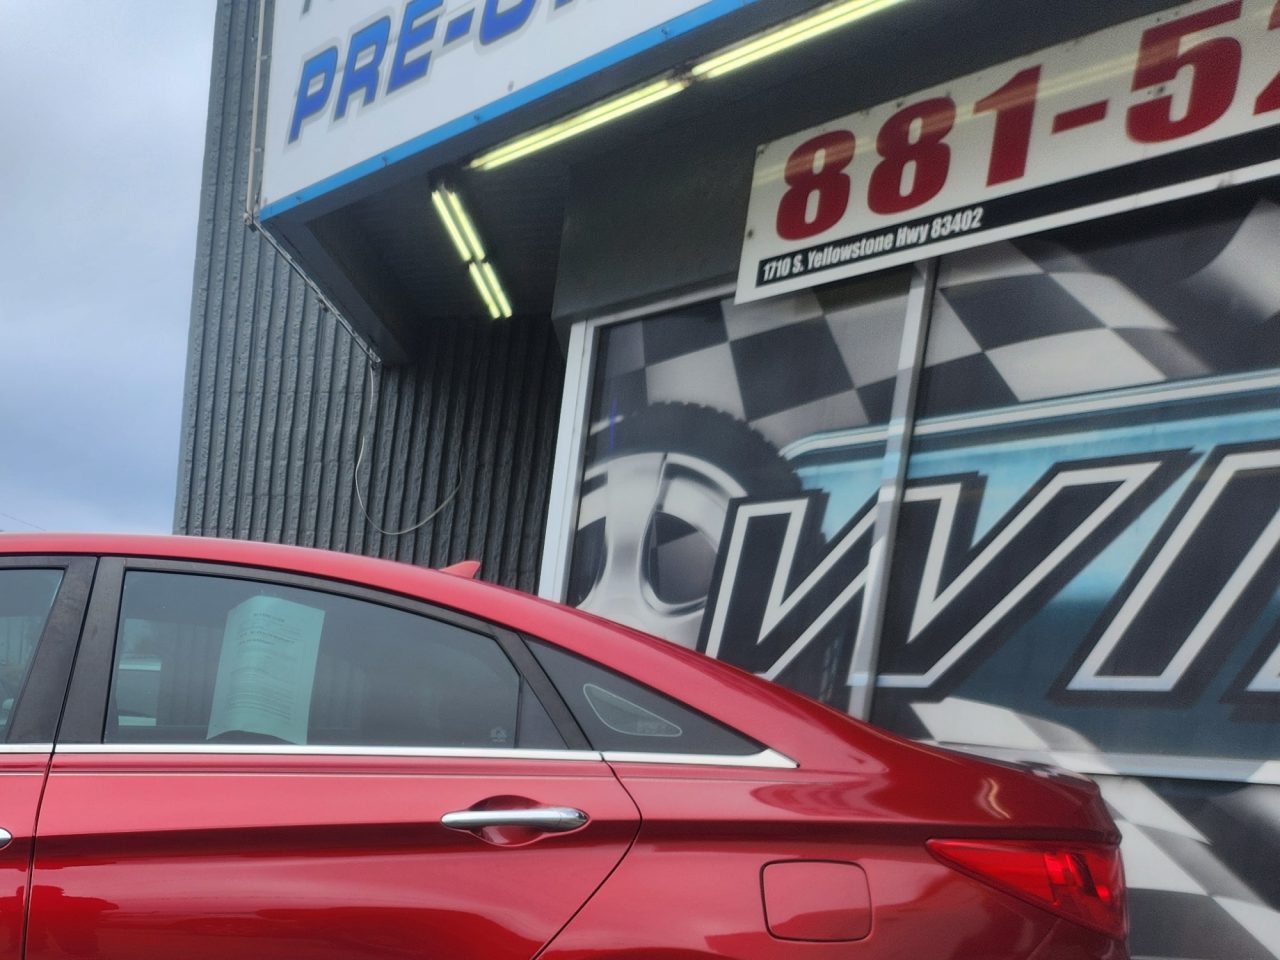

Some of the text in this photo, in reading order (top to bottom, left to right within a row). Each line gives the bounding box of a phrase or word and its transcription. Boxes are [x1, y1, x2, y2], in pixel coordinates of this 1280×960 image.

[763, 206, 984, 282] 1710 S. Yellowstone Hwy 83402
